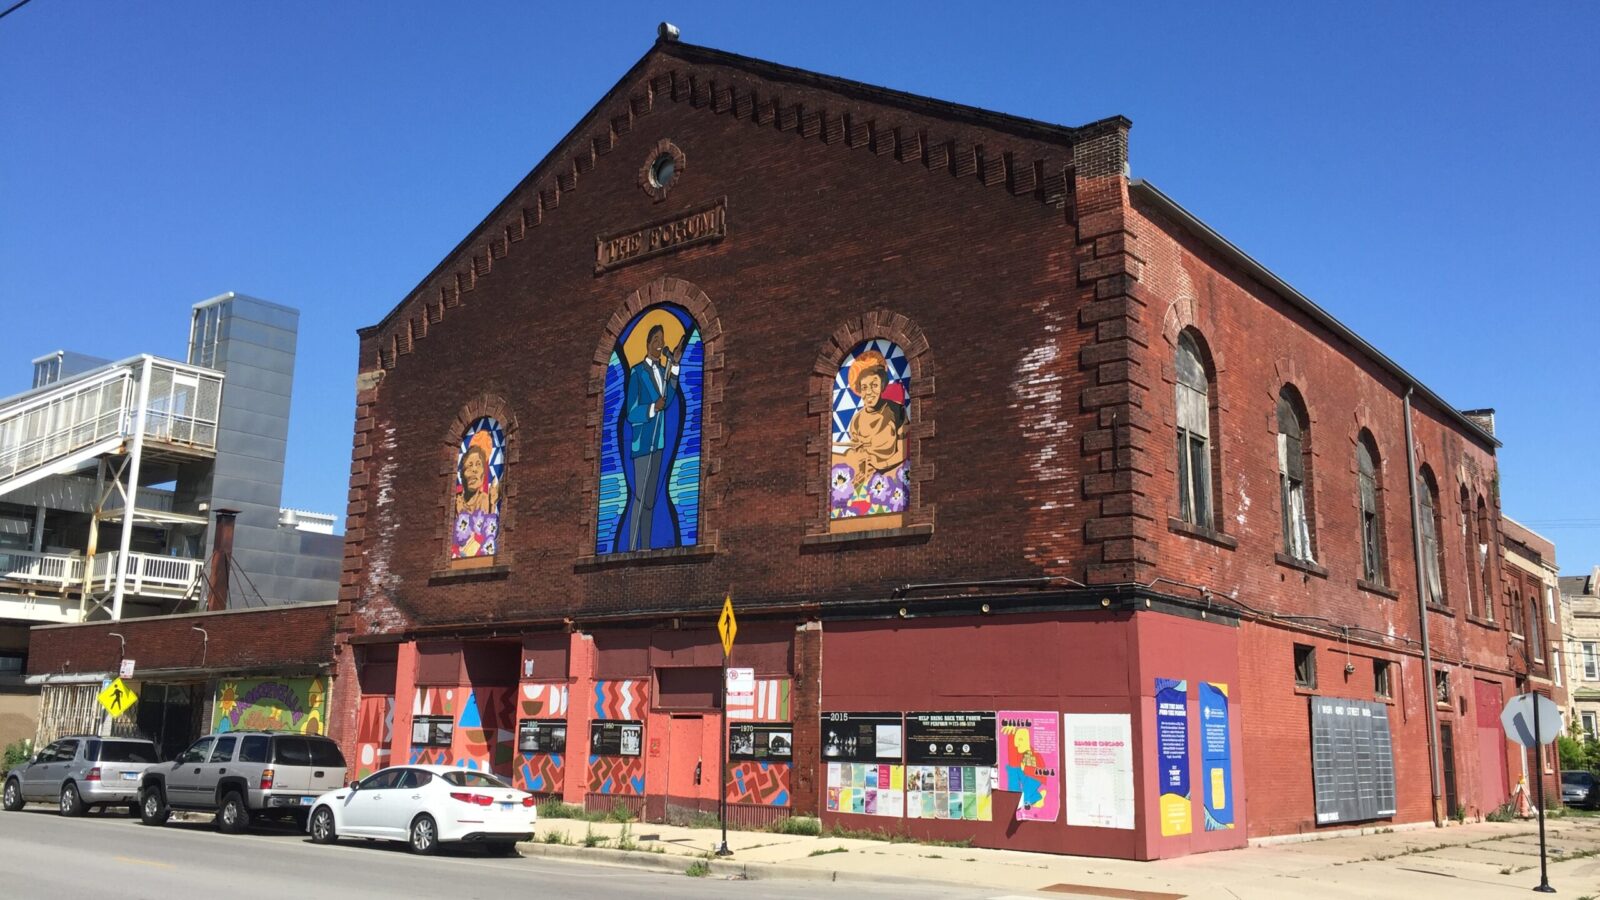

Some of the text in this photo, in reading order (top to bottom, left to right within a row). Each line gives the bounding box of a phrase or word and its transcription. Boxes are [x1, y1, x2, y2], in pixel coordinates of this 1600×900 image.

[607, 209, 716, 264] THE FORUM
[830, 712, 849, 722] 2015
